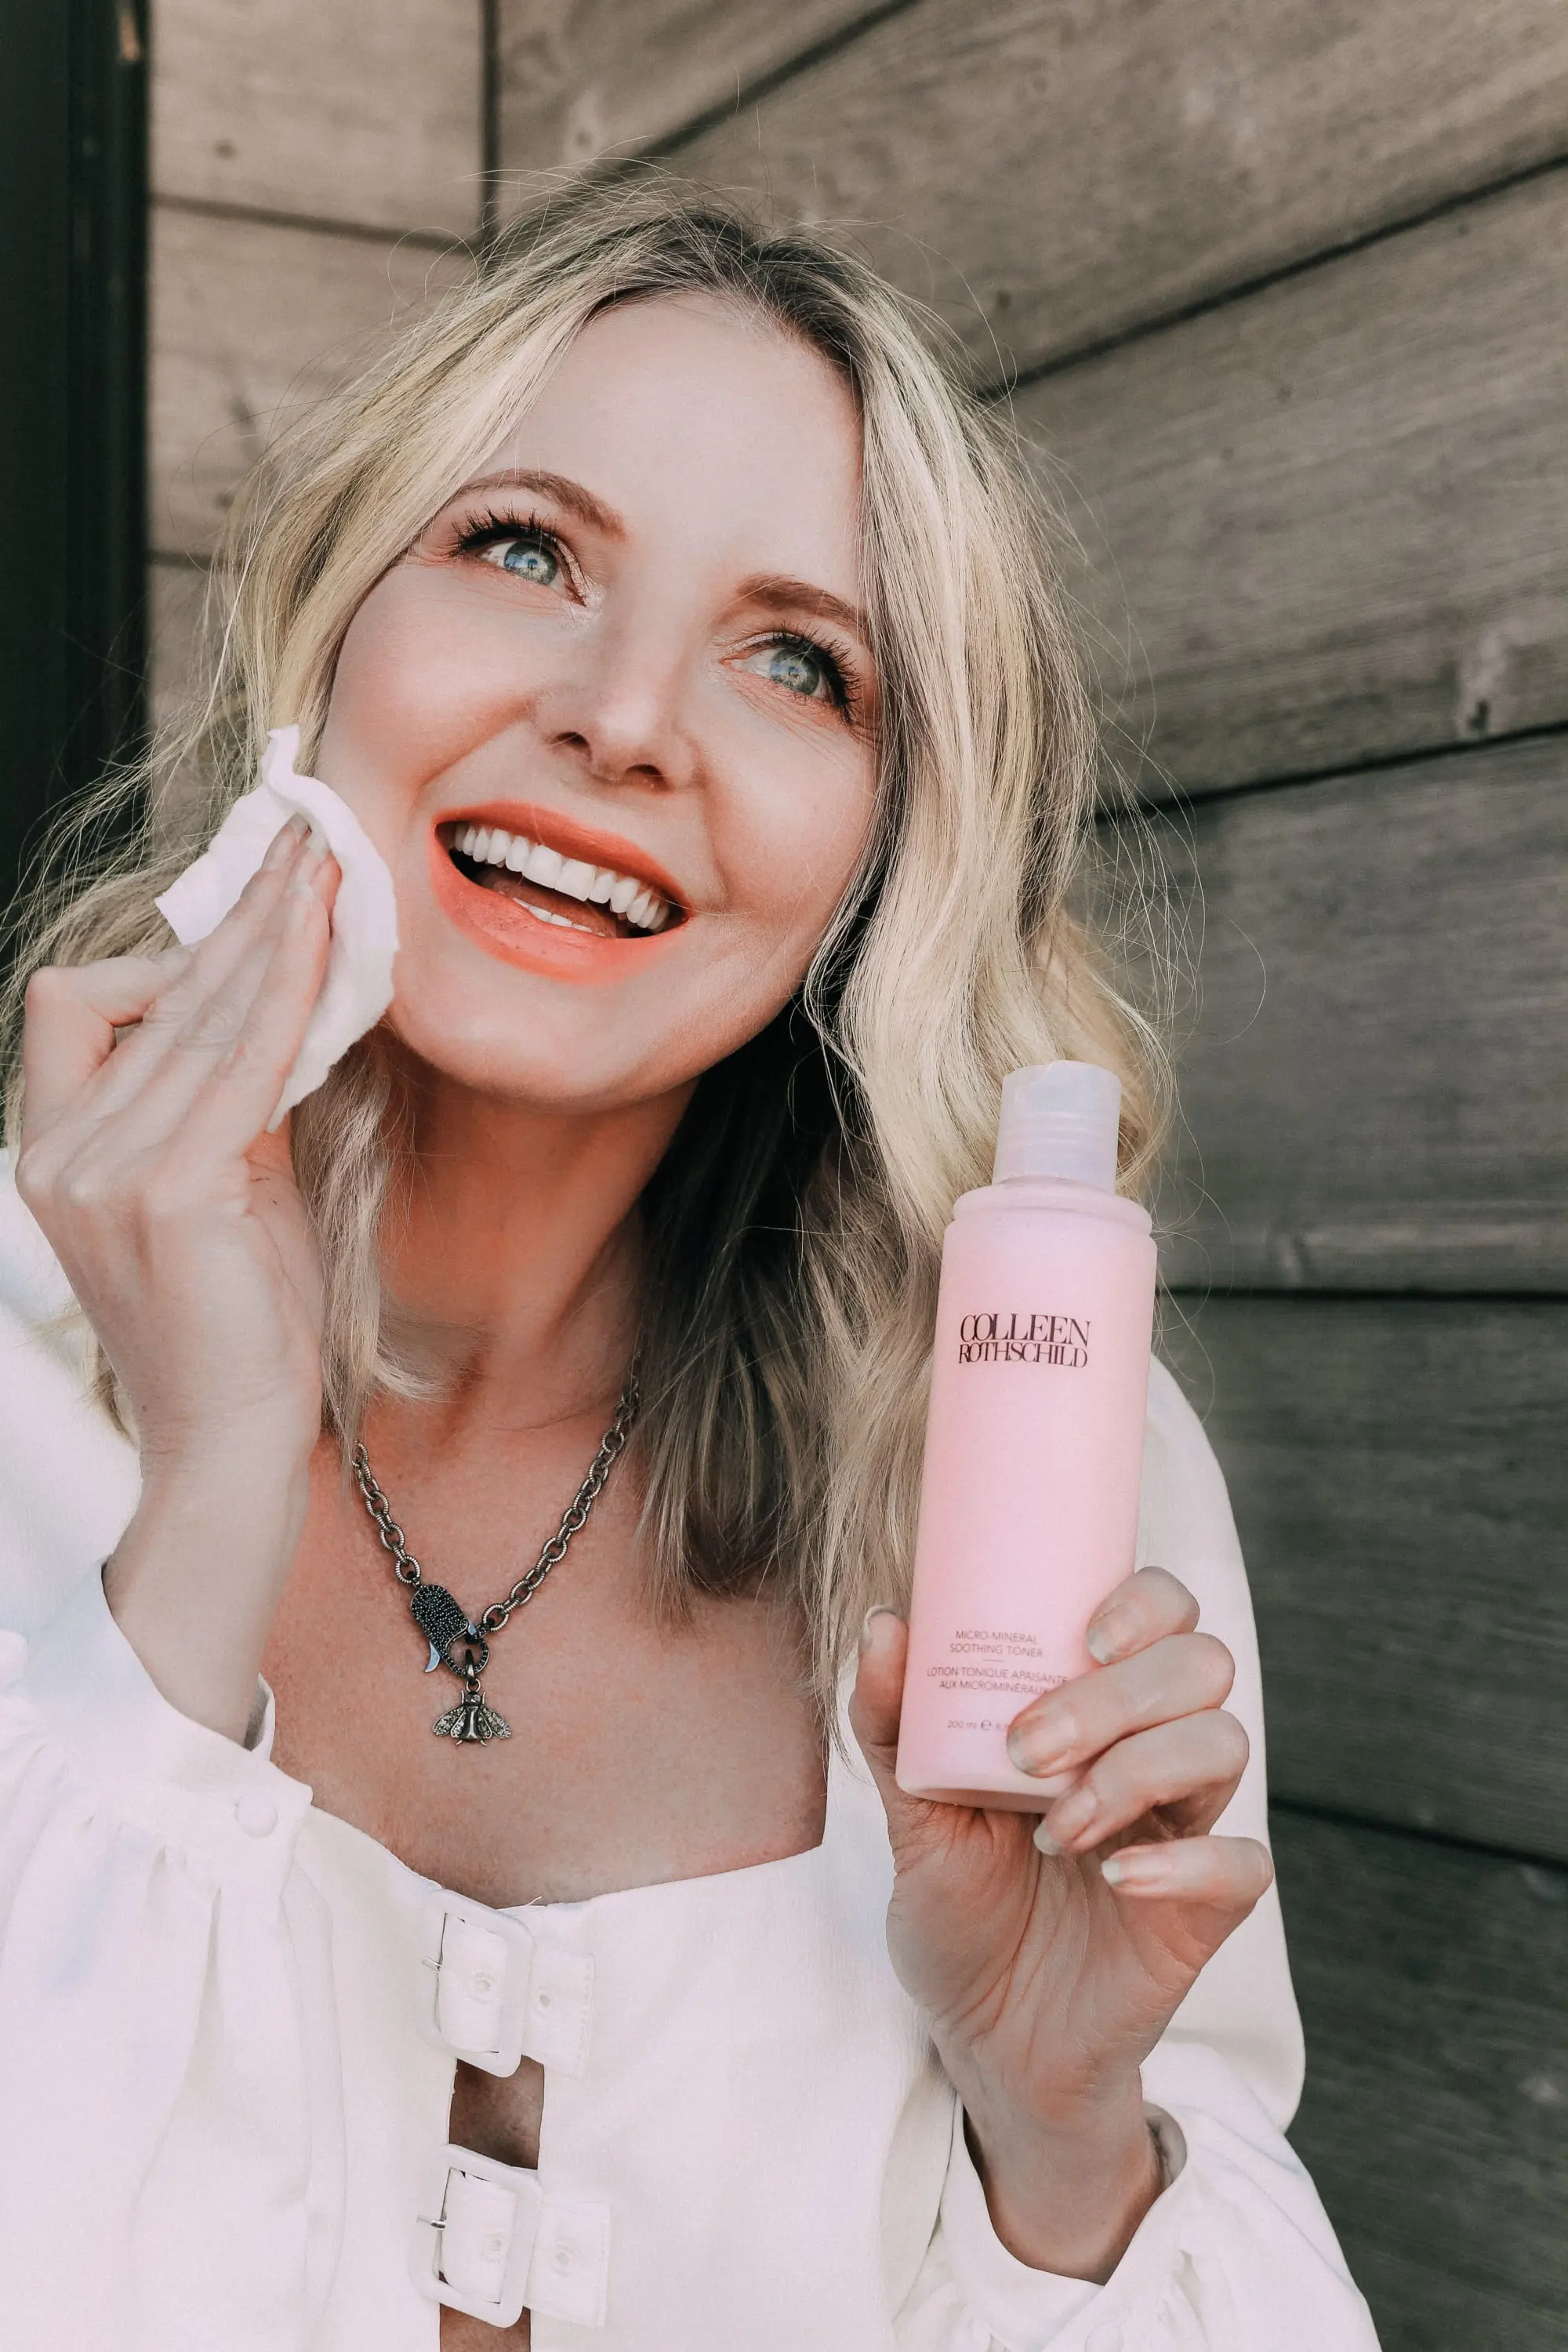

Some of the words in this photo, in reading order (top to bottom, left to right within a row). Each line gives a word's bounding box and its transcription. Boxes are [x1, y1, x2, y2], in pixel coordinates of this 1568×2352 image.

[960, 1313, 1091, 1348] COLLEEN
[958, 1341, 1088, 1368] ROTHSCHILD
[955, 1630, 1038, 1644] MICRO-MINERAL
[949, 1643, 1004, 1654] SOOTHING
[1007, 1645, 1044, 1657] TONER
[927, 1667, 958, 1677] LOTION
[961, 1667, 1008, 1678] TONIQUE
[939, 1680, 957, 1690] AUX
